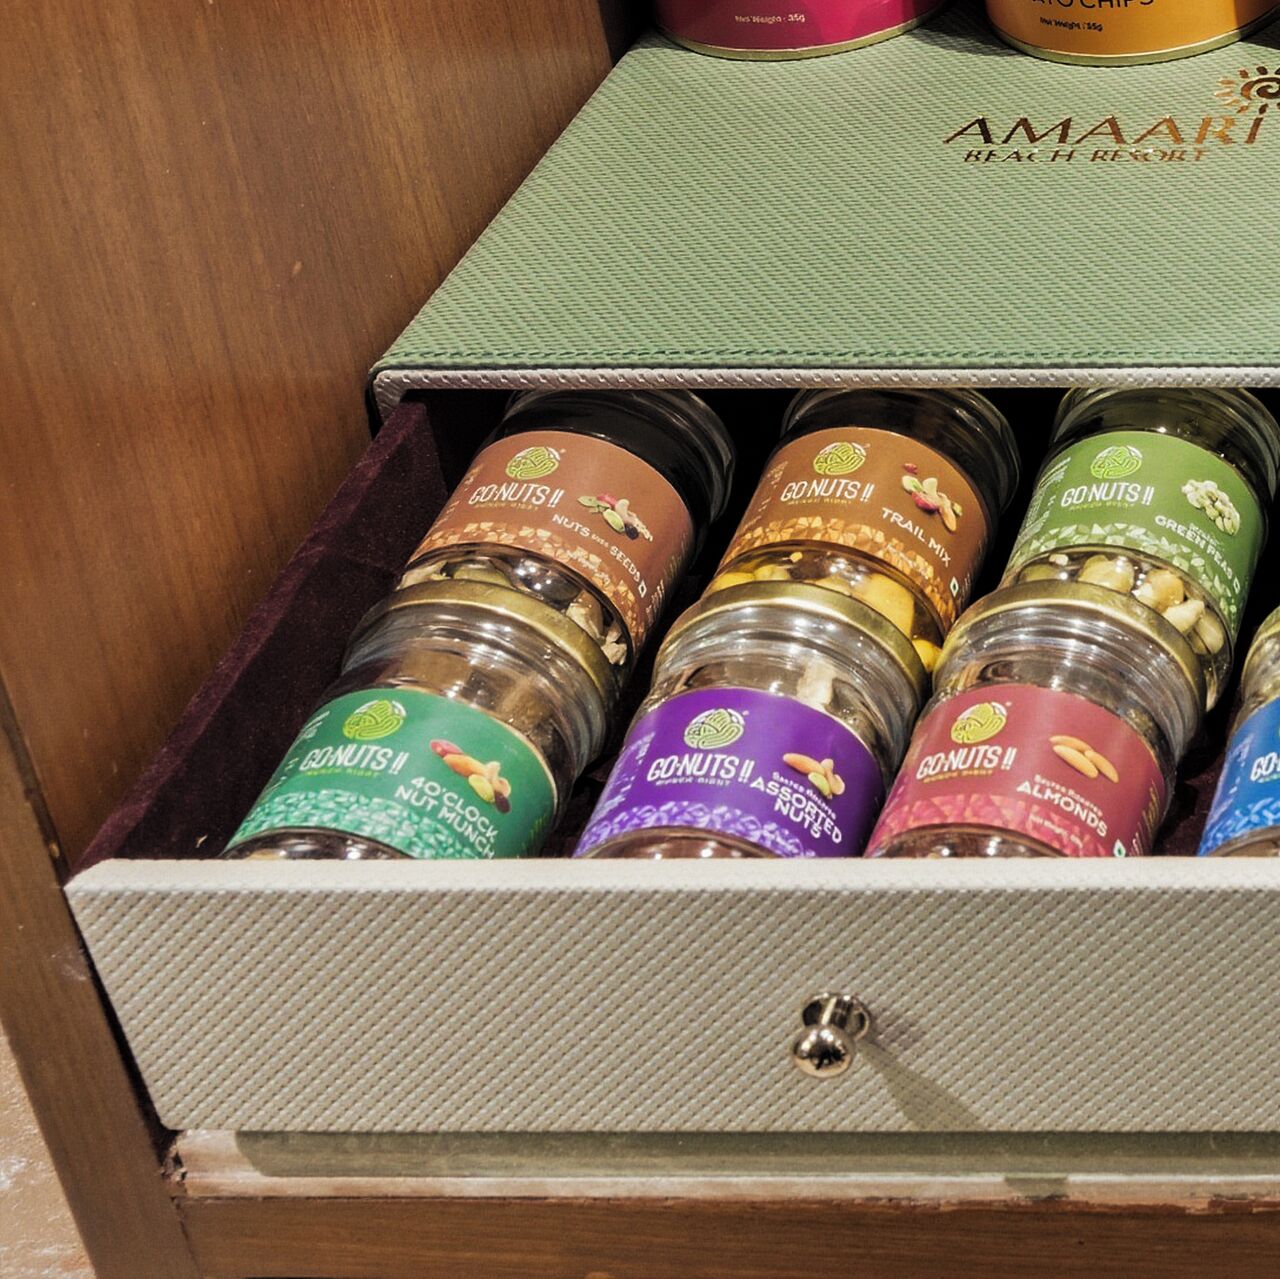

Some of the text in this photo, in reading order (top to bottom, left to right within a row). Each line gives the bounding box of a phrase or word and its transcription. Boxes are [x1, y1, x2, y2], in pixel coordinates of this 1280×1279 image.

[942, 115, 1264, 145] AMAARI
[964, 149, 1208, 163] BEACH RESORT
[552, 513, 591, 537] NUTS
[609, 545, 641, 583] SEEDS
[882, 507, 926, 542] TRAIL
[927, 537, 952, 568] MIX
[1154, 515, 1207, 549] GREEN
[1206, 545, 1233, 580] PEAS
[394, 784, 496, 859] NUT MUNCH
[750, 776, 842, 844] ASSORTED
[774, 800, 822, 839] NUTS
[1016, 780, 1108, 838] ALMONDS
